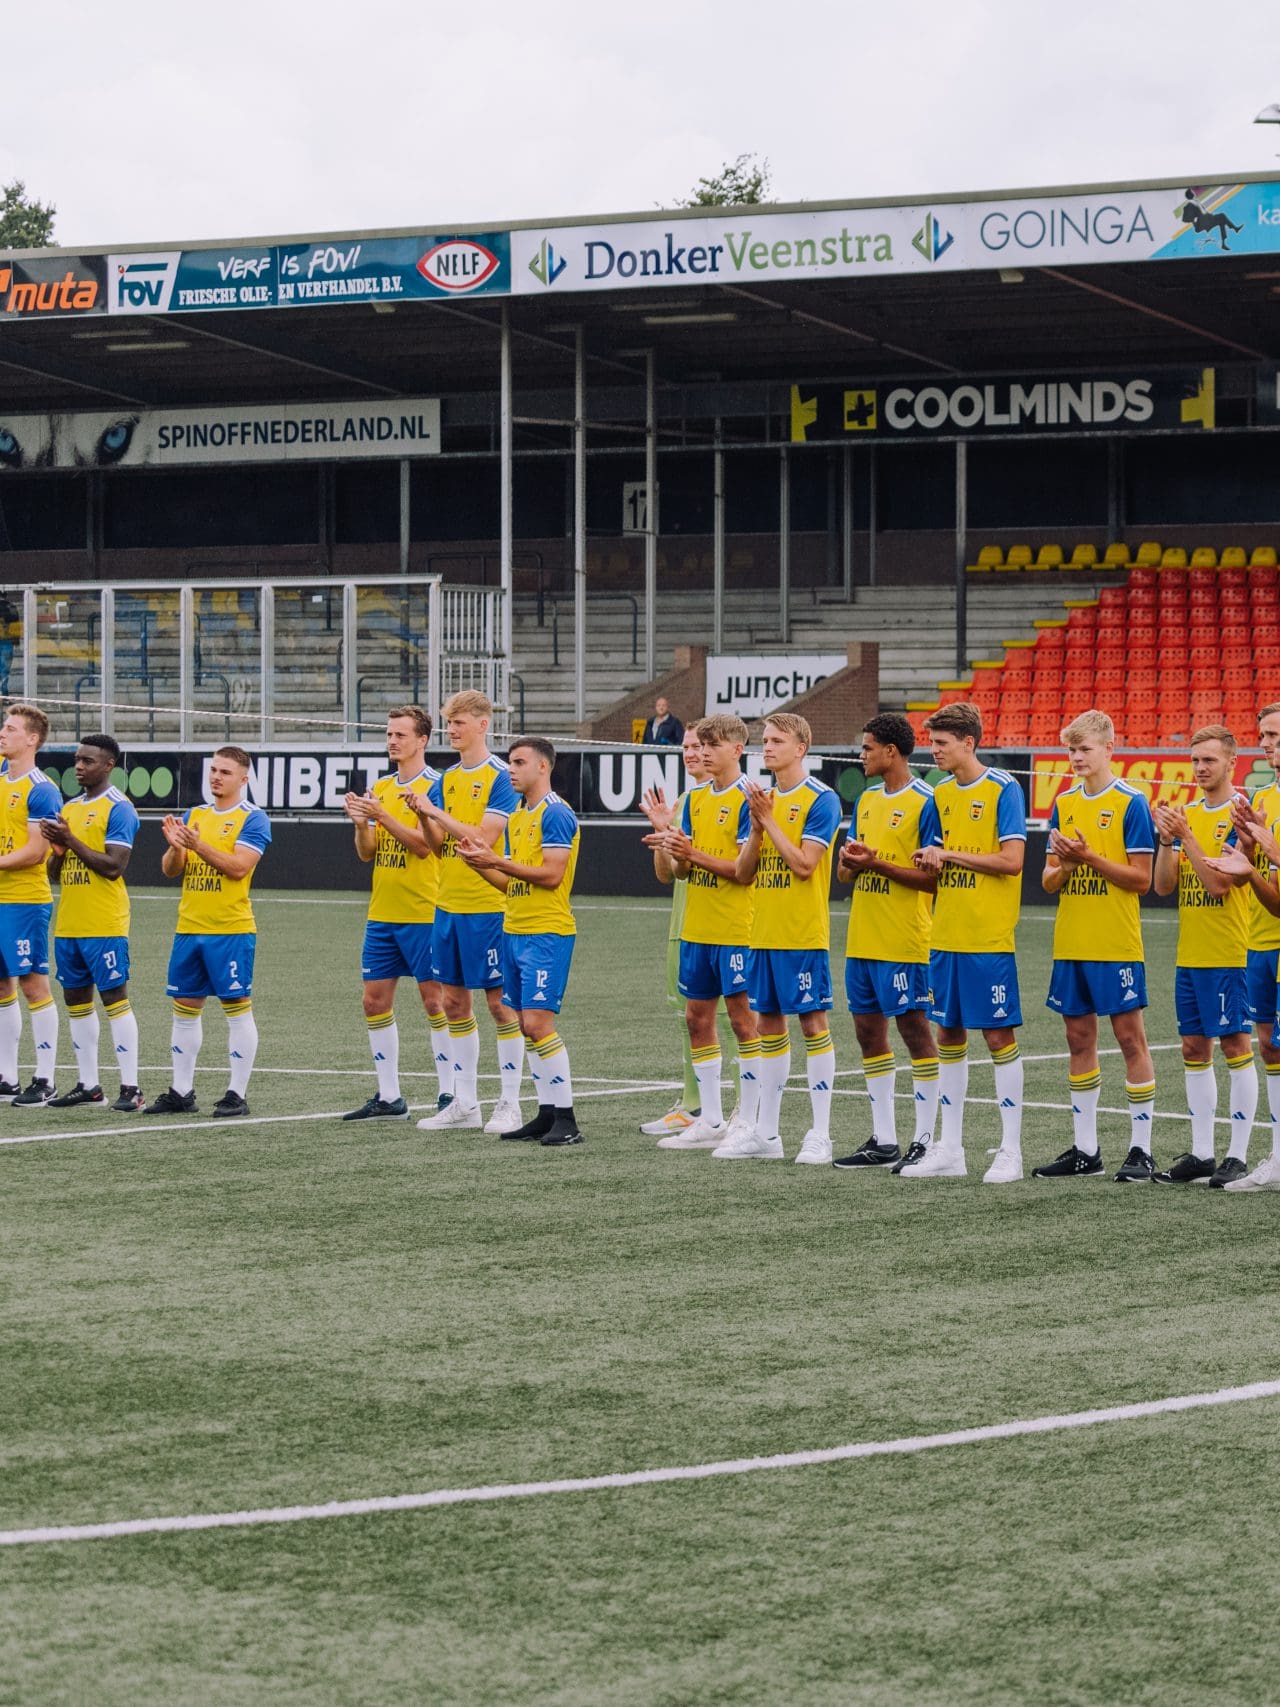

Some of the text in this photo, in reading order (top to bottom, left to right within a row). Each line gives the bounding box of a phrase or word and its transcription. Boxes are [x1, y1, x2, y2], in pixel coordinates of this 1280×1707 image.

[979, 203, 1155, 251] GOINGA
[217, 245, 361, 280] VERF IS FOV!
[436, 252, 480, 278] NELF
[6, 272, 98, 312] muta
[178, 275, 404, 306] FRIESCHE OLIE- EN VERFHANDEL B.V.
[884, 379, 1155, 430] COOLMINDS
[157, 414, 431, 450] SPINOFFNEDERLAND.NL
[202, 756, 389, 808] NIBET
[16, 939, 31, 956] 33
[229, 960, 239, 978] 2
[729, 953, 745, 972] 49
[536, 969, 548, 988] 12
[798, 971, 812, 991] 39
[893, 972, 909, 992] 40
[1118, 967, 1135, 988] 38
[991, 984, 1007, 1004] 36
